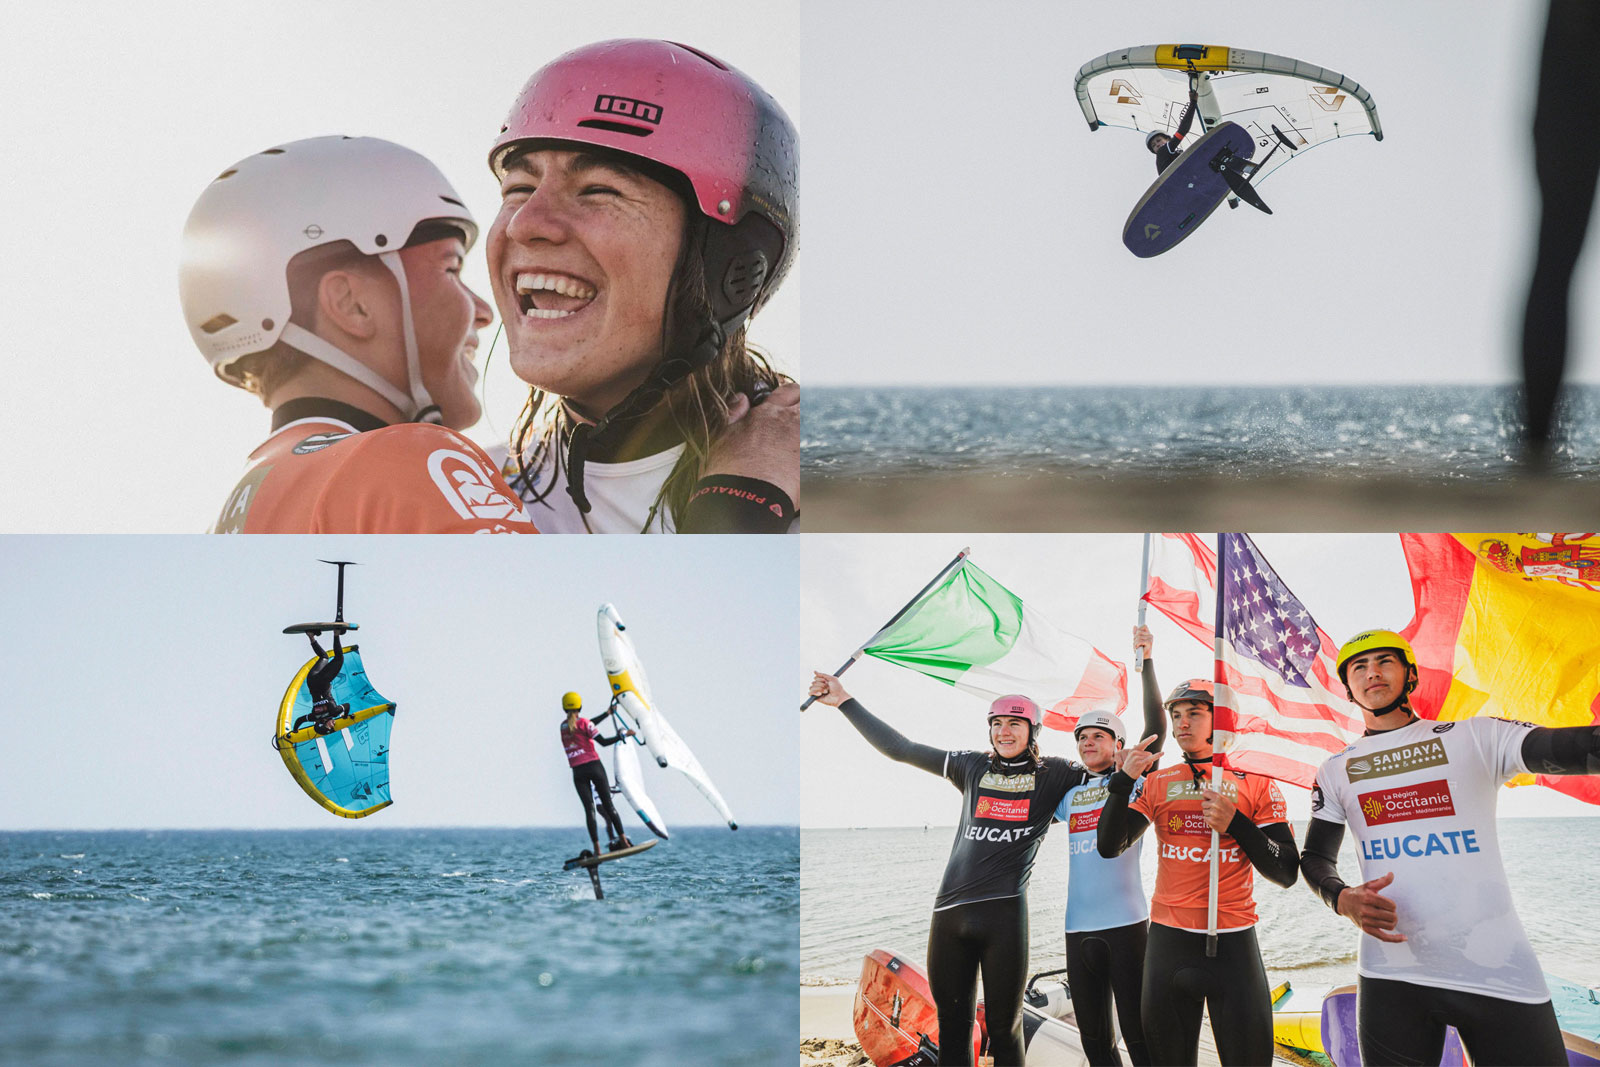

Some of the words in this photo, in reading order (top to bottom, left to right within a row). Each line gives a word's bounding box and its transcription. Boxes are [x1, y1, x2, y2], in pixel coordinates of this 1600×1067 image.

[1372, 742, 1442, 766] SANDAYA
[1385, 792, 1450, 811] Occitanie
[1392, 789, 1418, 800] Région
[991, 805, 1028, 815] Occitanie
[964, 824, 1034, 843] LEUCATE
[1361, 829, 1480, 860] LEUCATE
